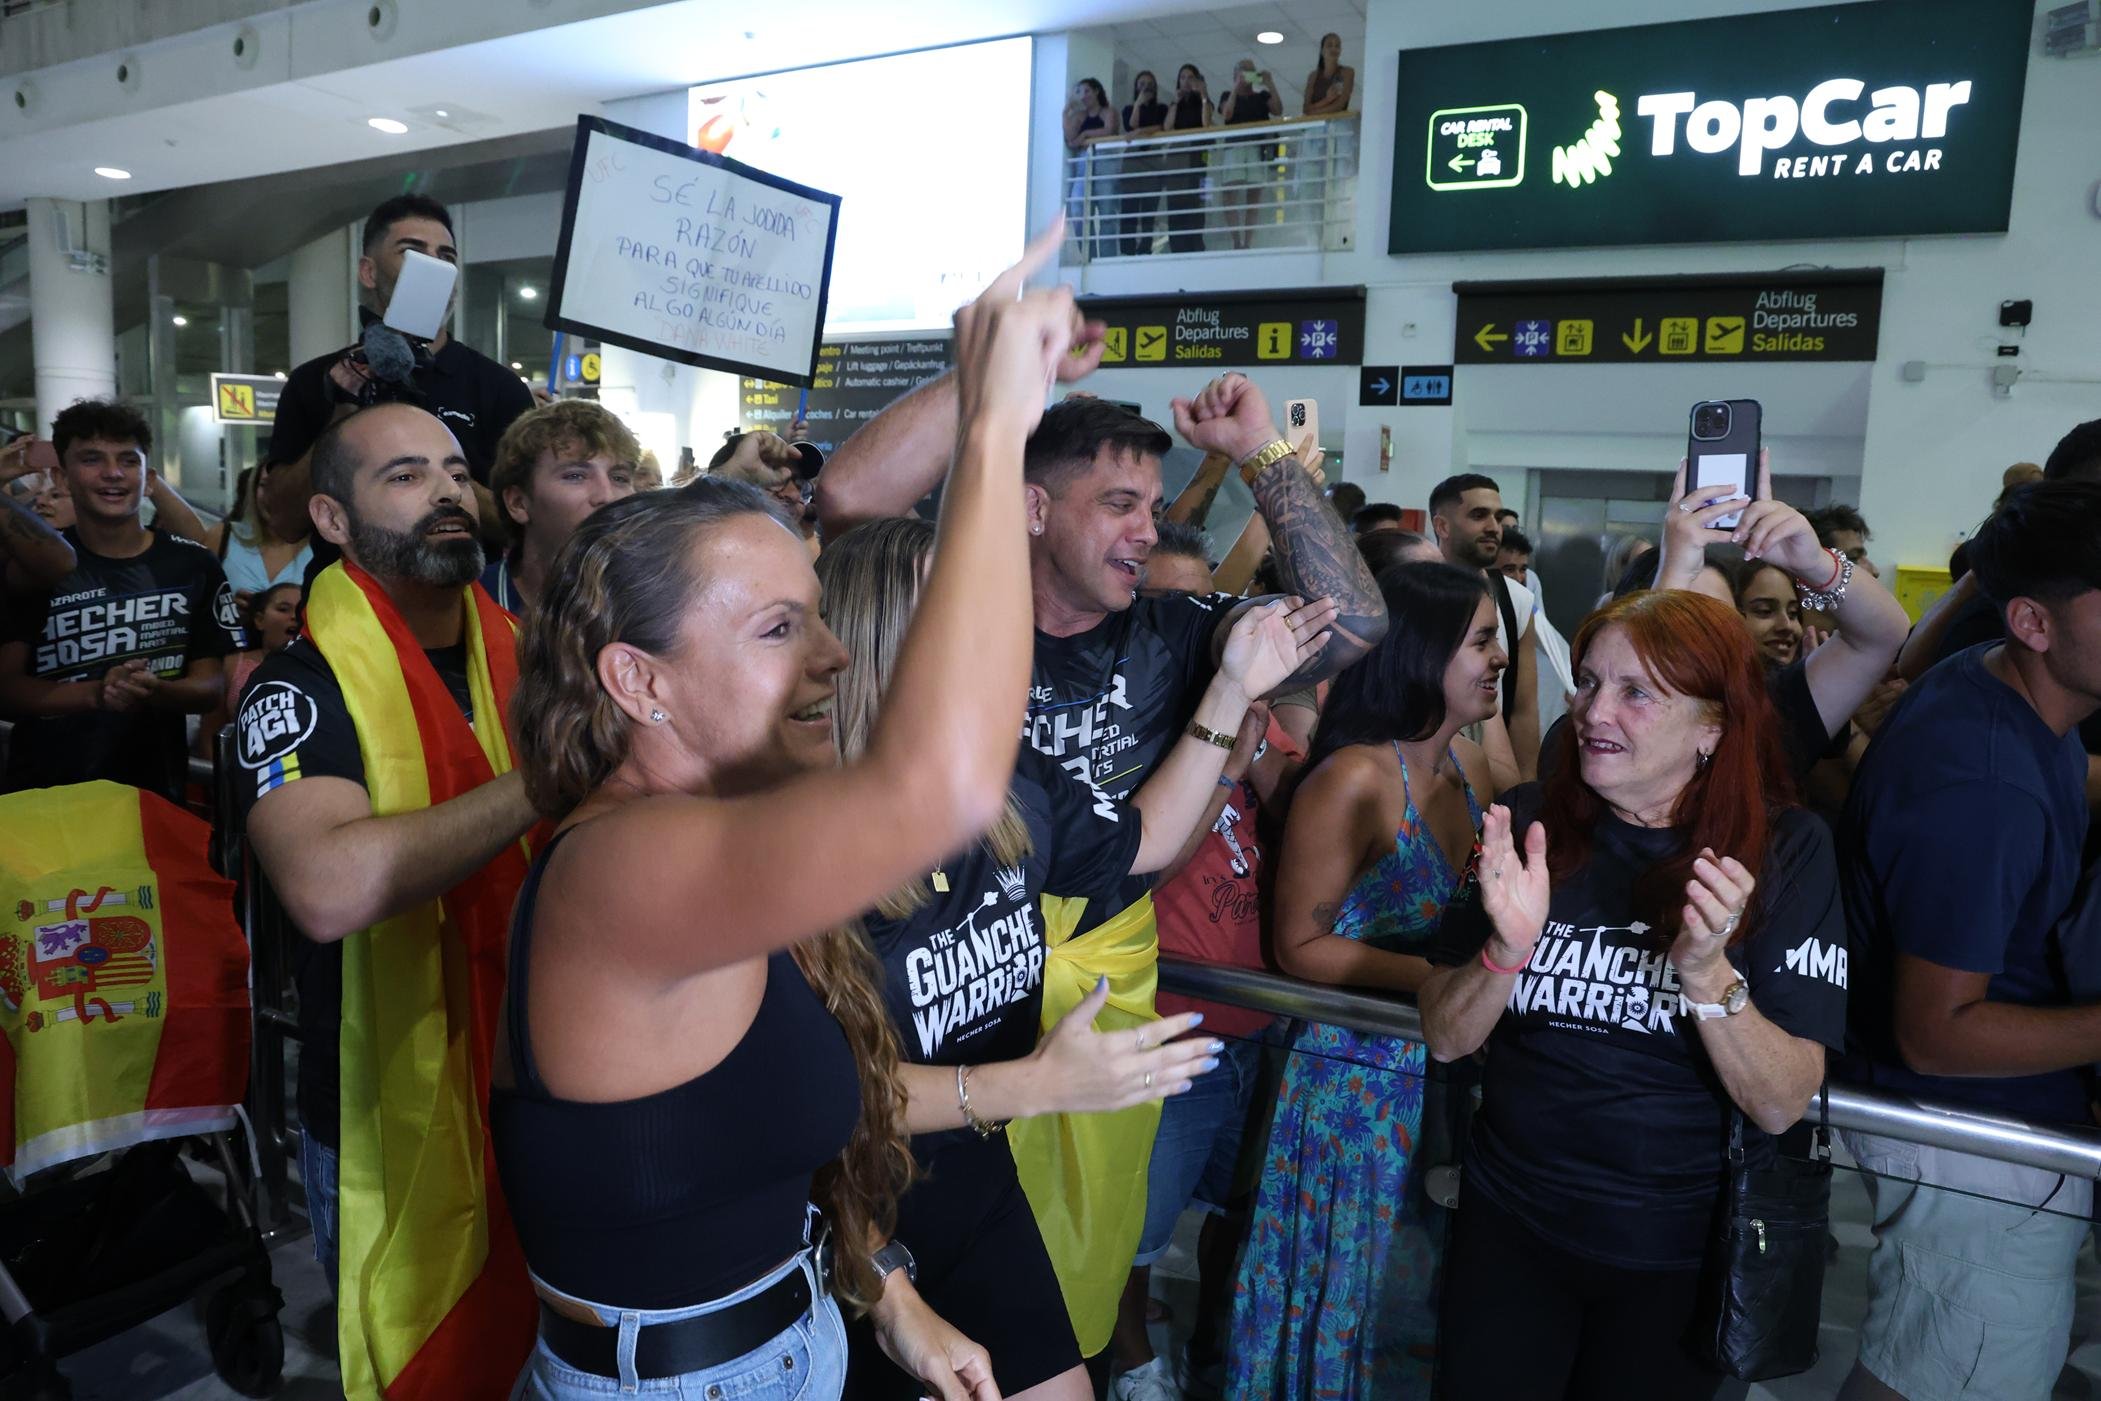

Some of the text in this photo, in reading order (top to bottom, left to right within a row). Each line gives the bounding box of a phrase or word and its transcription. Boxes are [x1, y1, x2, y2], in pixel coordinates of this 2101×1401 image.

[1440, 118, 1513, 136] CAR RENTAL
[1457, 132, 1494, 148] DESK
[1637, 78, 1973, 176] TopCar
[1774, 149, 1943, 180] RENT A CAR
[650, 176, 796, 242] SÉ LA JODIDA
[675, 217, 759, 261] RAZÓN
[616, 236, 678, 269] PARA
[685, 258, 715, 281] QUE
[722, 266, 740, 285] TU
[633, 291, 693, 318] ALGO
[659, 277, 776, 317] SIGNIFIQUE
[1755, 290, 1817, 312] Abflug
[1175, 308, 1220, 325] Abflug
[1753, 310, 1858, 331] Departures
[1175, 324, 1250, 343] Departures
[1752, 333, 1825, 352] Salidas
[1175, 344, 1222, 360] Salidas
[36, 626, 137, 672] SOSA
[240, 690, 295, 731] PATCH
[929, 929, 956, 951] THE
[1546, 920, 1577, 938] THE
[906, 902, 1040, 1007] GUANCHE
[1525, 932, 1681, 992] UANCHE
[956, 1016, 1002, 1044] HECHER SOSA
[1549, 1020, 1609, 1035] HECHER SOSA
